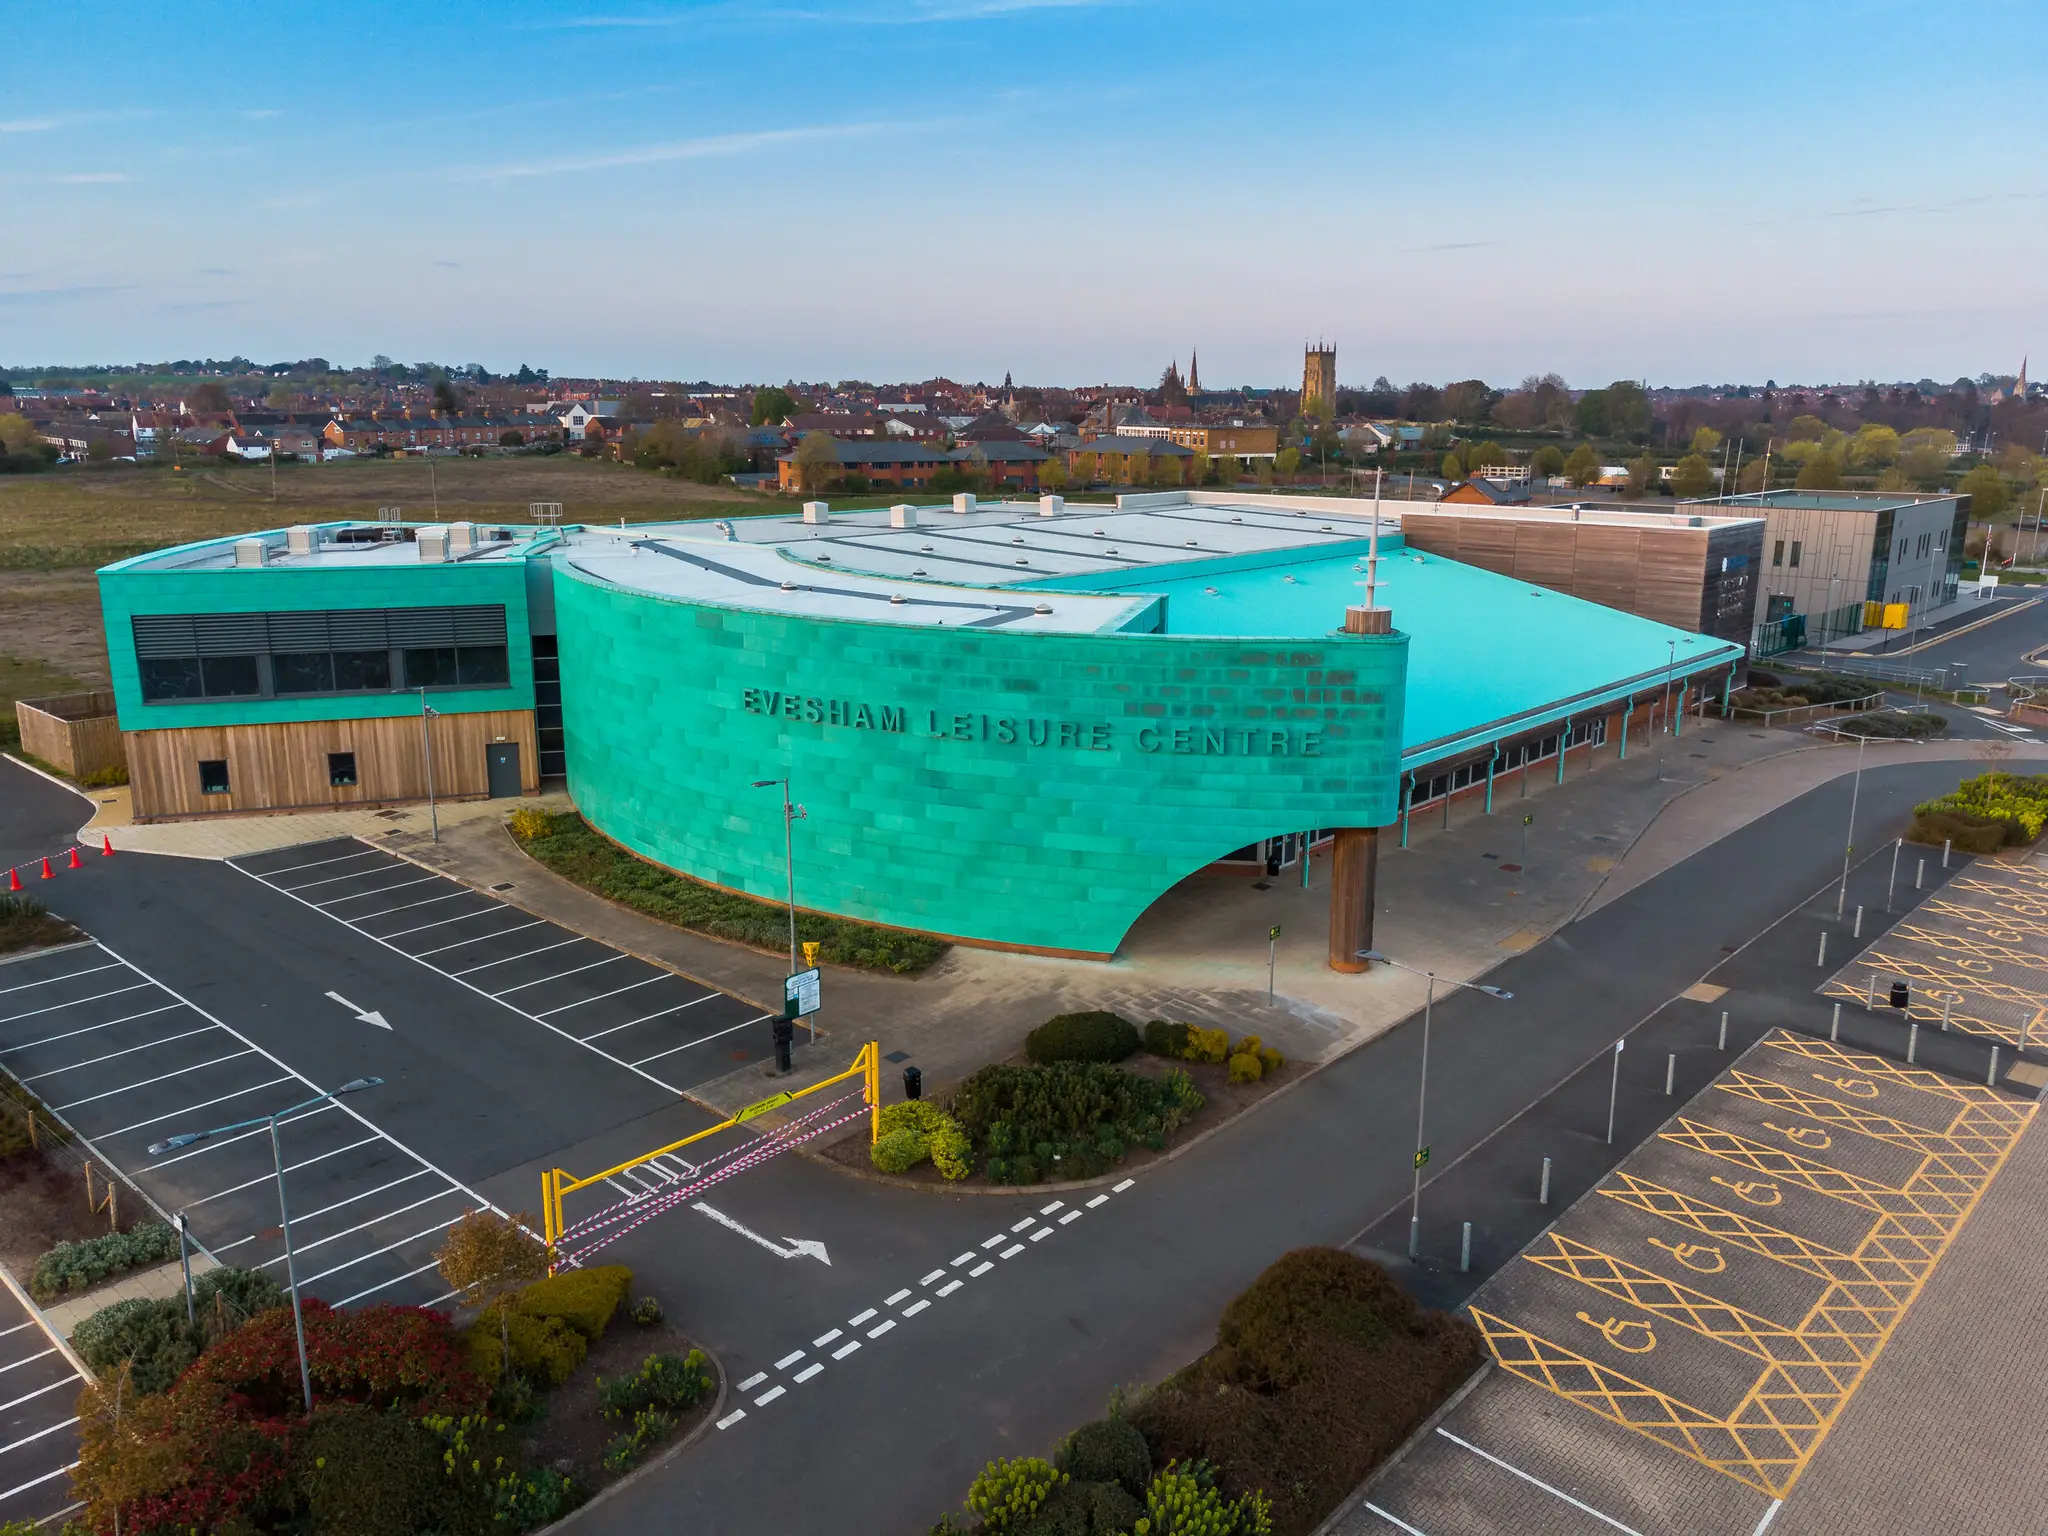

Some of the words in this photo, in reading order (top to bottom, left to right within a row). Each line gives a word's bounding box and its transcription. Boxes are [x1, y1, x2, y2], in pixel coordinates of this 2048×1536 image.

[743, 687, 904, 733] EVESHAM
[929, 709, 1111, 751] LEISURE
[1138, 724, 1322, 757] CENTRE
